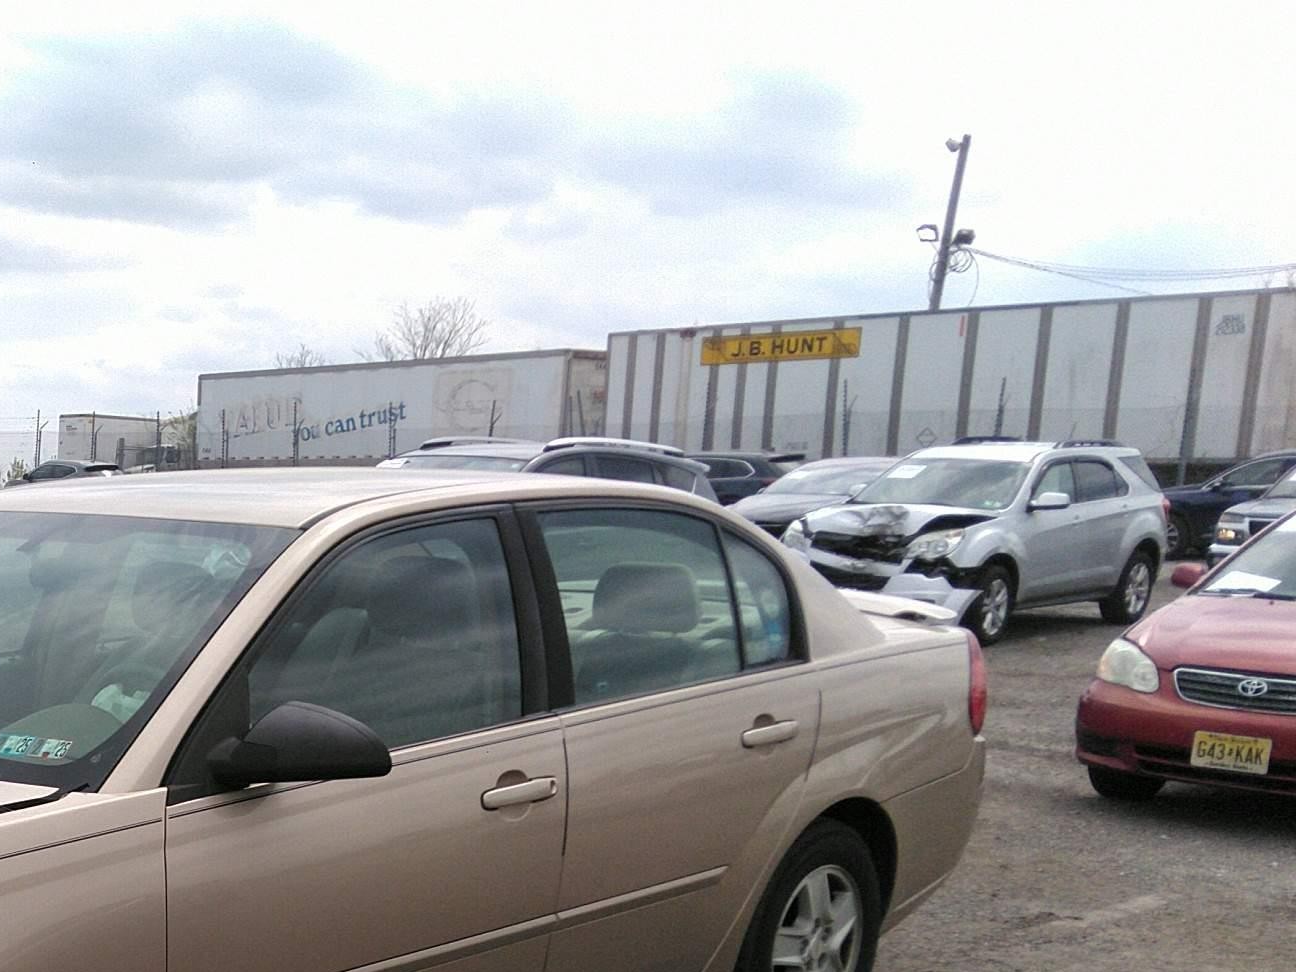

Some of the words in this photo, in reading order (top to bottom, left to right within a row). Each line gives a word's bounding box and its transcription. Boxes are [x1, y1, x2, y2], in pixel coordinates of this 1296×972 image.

[771, 335, 828, 354] HUNT
[325, 416, 357, 436] can
[358, 401, 406, 426] trust
